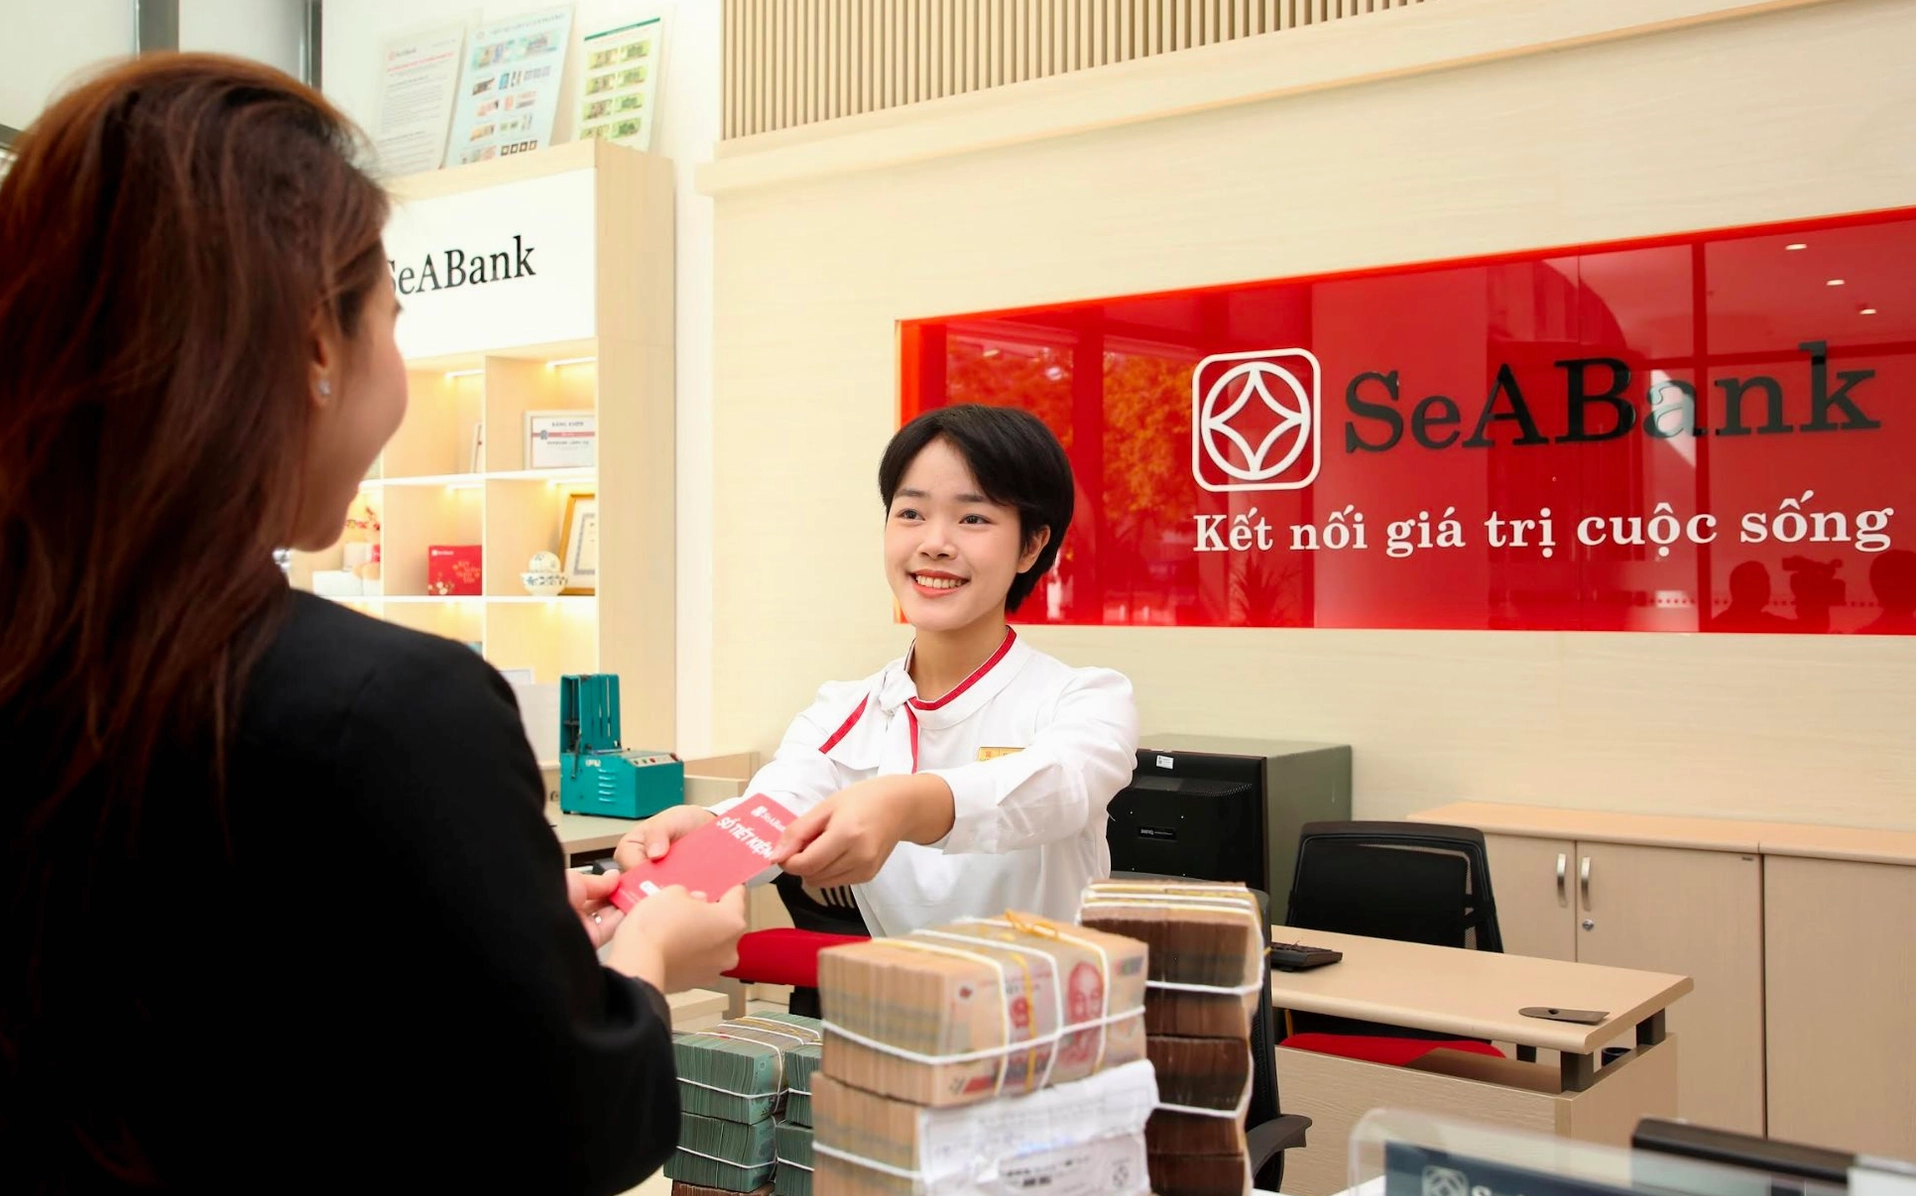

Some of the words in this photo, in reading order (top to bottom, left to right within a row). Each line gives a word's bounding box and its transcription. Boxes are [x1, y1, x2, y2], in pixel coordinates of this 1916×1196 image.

[1345, 341, 1881, 454] SeABank
[1193, 507, 1273, 552] Kết
[1290, 504, 1368, 550] nối
[1386, 506, 1466, 558] giá
[1484, 507, 1556, 558] trị
[1577, 502, 1718, 558] cuộc
[1740, 490, 1895, 552] sống
